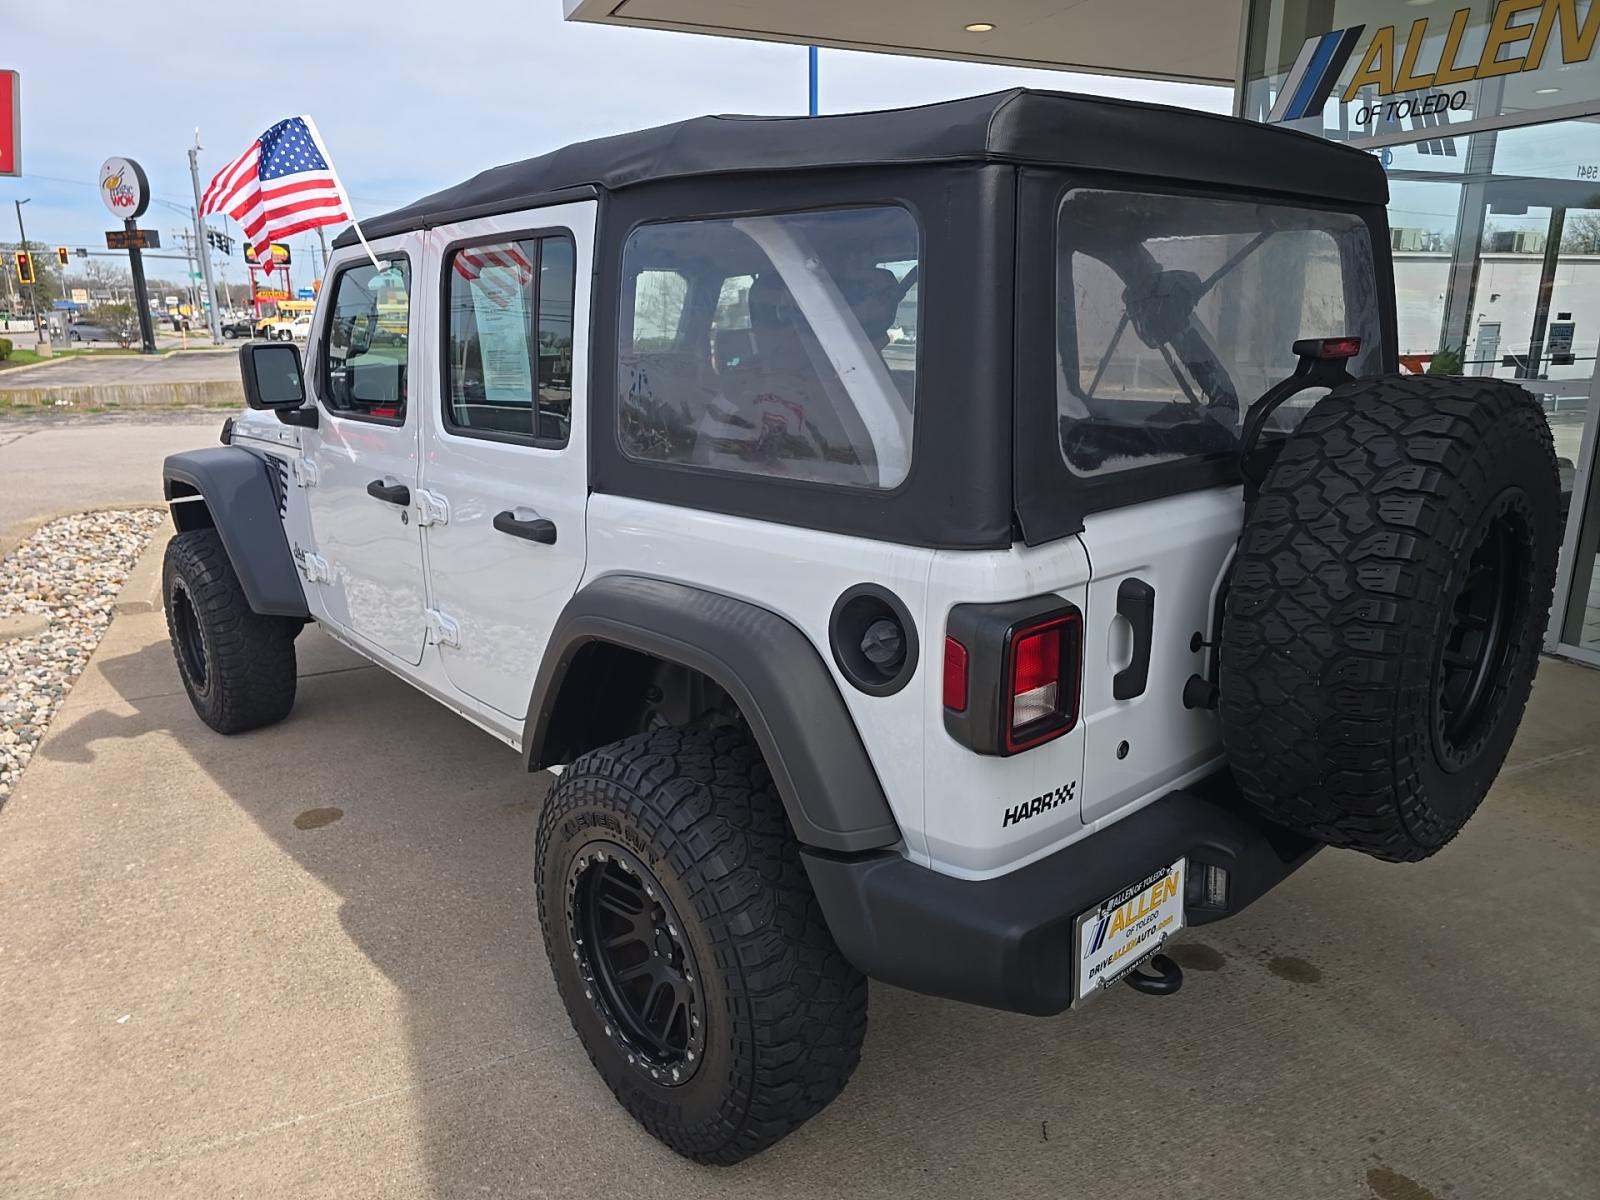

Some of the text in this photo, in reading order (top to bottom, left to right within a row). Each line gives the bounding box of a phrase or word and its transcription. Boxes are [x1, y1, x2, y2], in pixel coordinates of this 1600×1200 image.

[1340, 0, 1600, 103] ALLEN
[1355, 90, 1467, 126] OF TOLEDO
[113, 194, 135, 207] WOK
[1144, 867, 1165, 888] TOLEDO
[1108, 870, 1180, 939] ALLEN
[1135, 910, 1160, 934] TOLEDO
